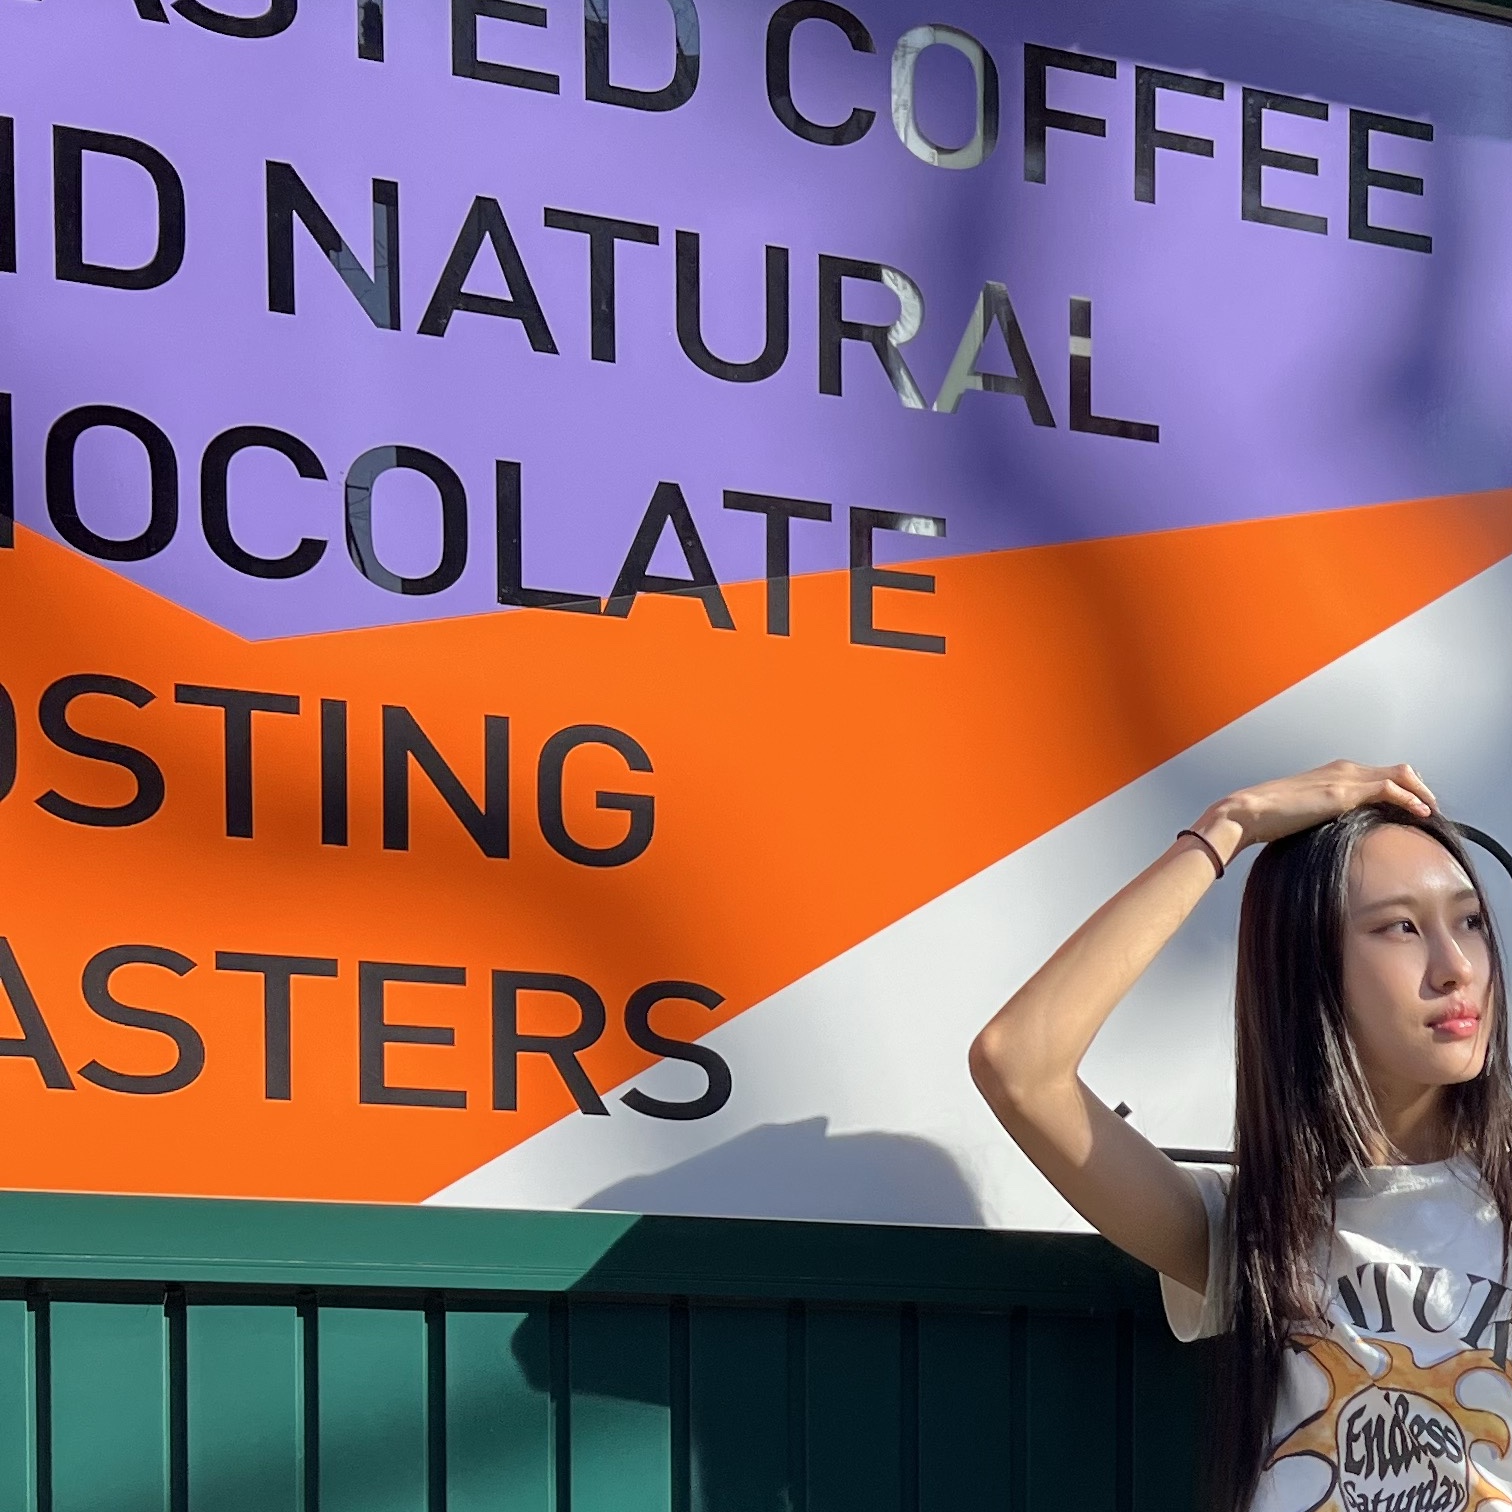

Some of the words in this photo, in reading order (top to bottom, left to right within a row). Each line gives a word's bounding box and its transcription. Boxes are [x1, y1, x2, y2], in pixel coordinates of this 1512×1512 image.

[766, 0, 1433, 253] COFFEE
[0, 115, 186, 291] D
[265, 160, 1160, 444] NATURAL
[0, 391, 947, 655] OCOLATE
[0, 673, 656, 868] STING
[1344, 1391, 1464, 1481] Endless
